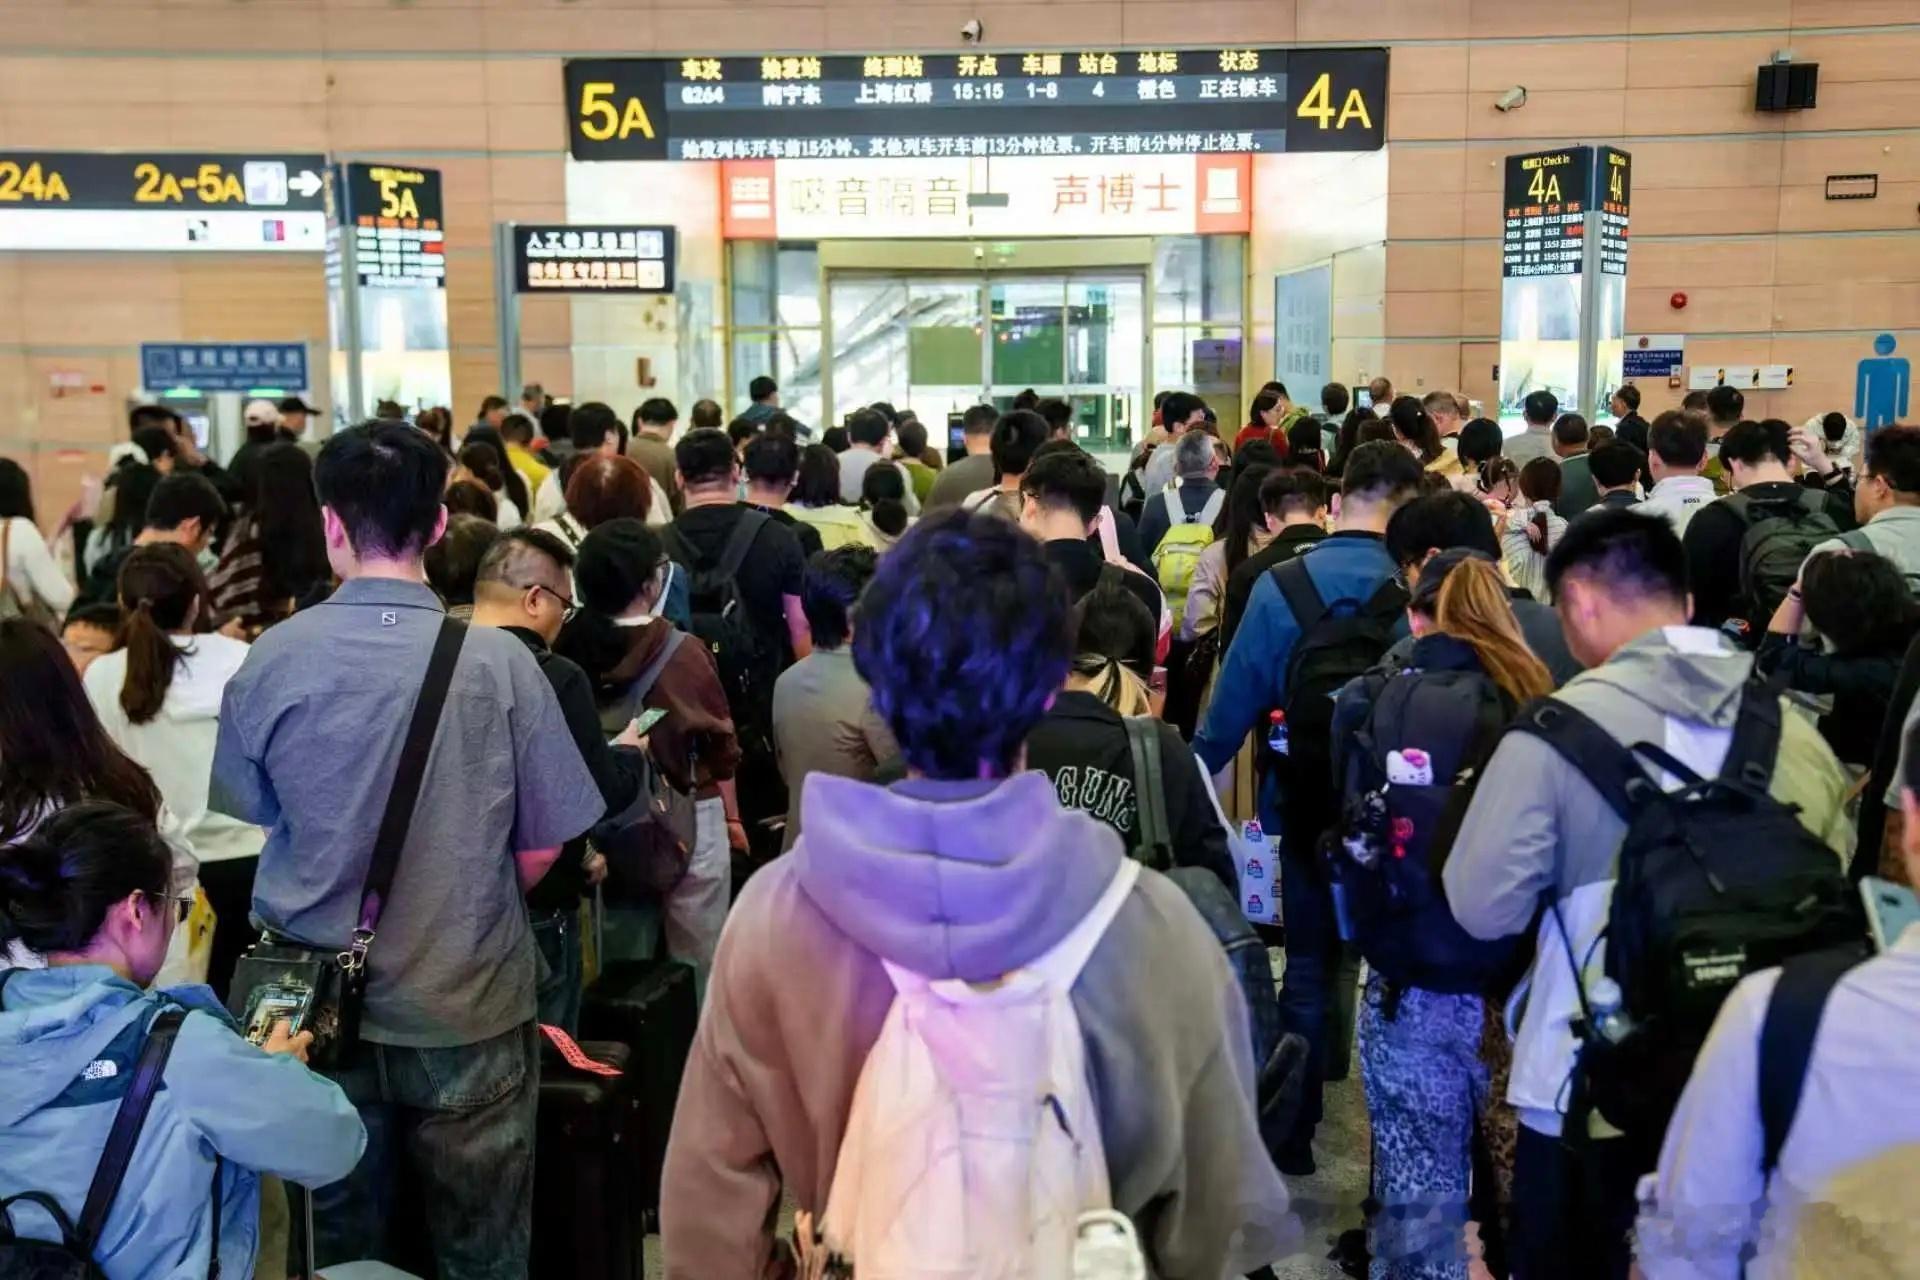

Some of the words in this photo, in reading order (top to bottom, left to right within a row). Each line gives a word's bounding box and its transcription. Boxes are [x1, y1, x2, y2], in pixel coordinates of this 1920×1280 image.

[682, 58, 722, 80] 车次
[761, 56, 821, 79] 始发站
[958, 54, 998, 76] 开点
[1022, 53, 1062, 75] 车厢
[1078, 52, 1118, 74] 站台
[1138, 51, 1178, 73] 地标
[1219, 49, 1259, 71] 状态
[762, 83, 822, 105] 南宁东
[855, 82, 933, 103] 上海虹桥
[952, 82, 1004, 99] 15:15
[1026, 81, 1058, 98] 1-8
[1092, 81, 1105, 97] 4
[1137, 79, 1176, 99] 橙色
[1199, 77, 1278, 98] 正在候车
[1296, 73, 1372, 130] 4A
[580, 82, 655, 141] 5A
[134, 163, 245, 202] 2A-5A
[381, 180, 419, 218] 5A
[1053, 173, 1181, 215] 声博士
[1528, 167, 1561, 204] 4A
